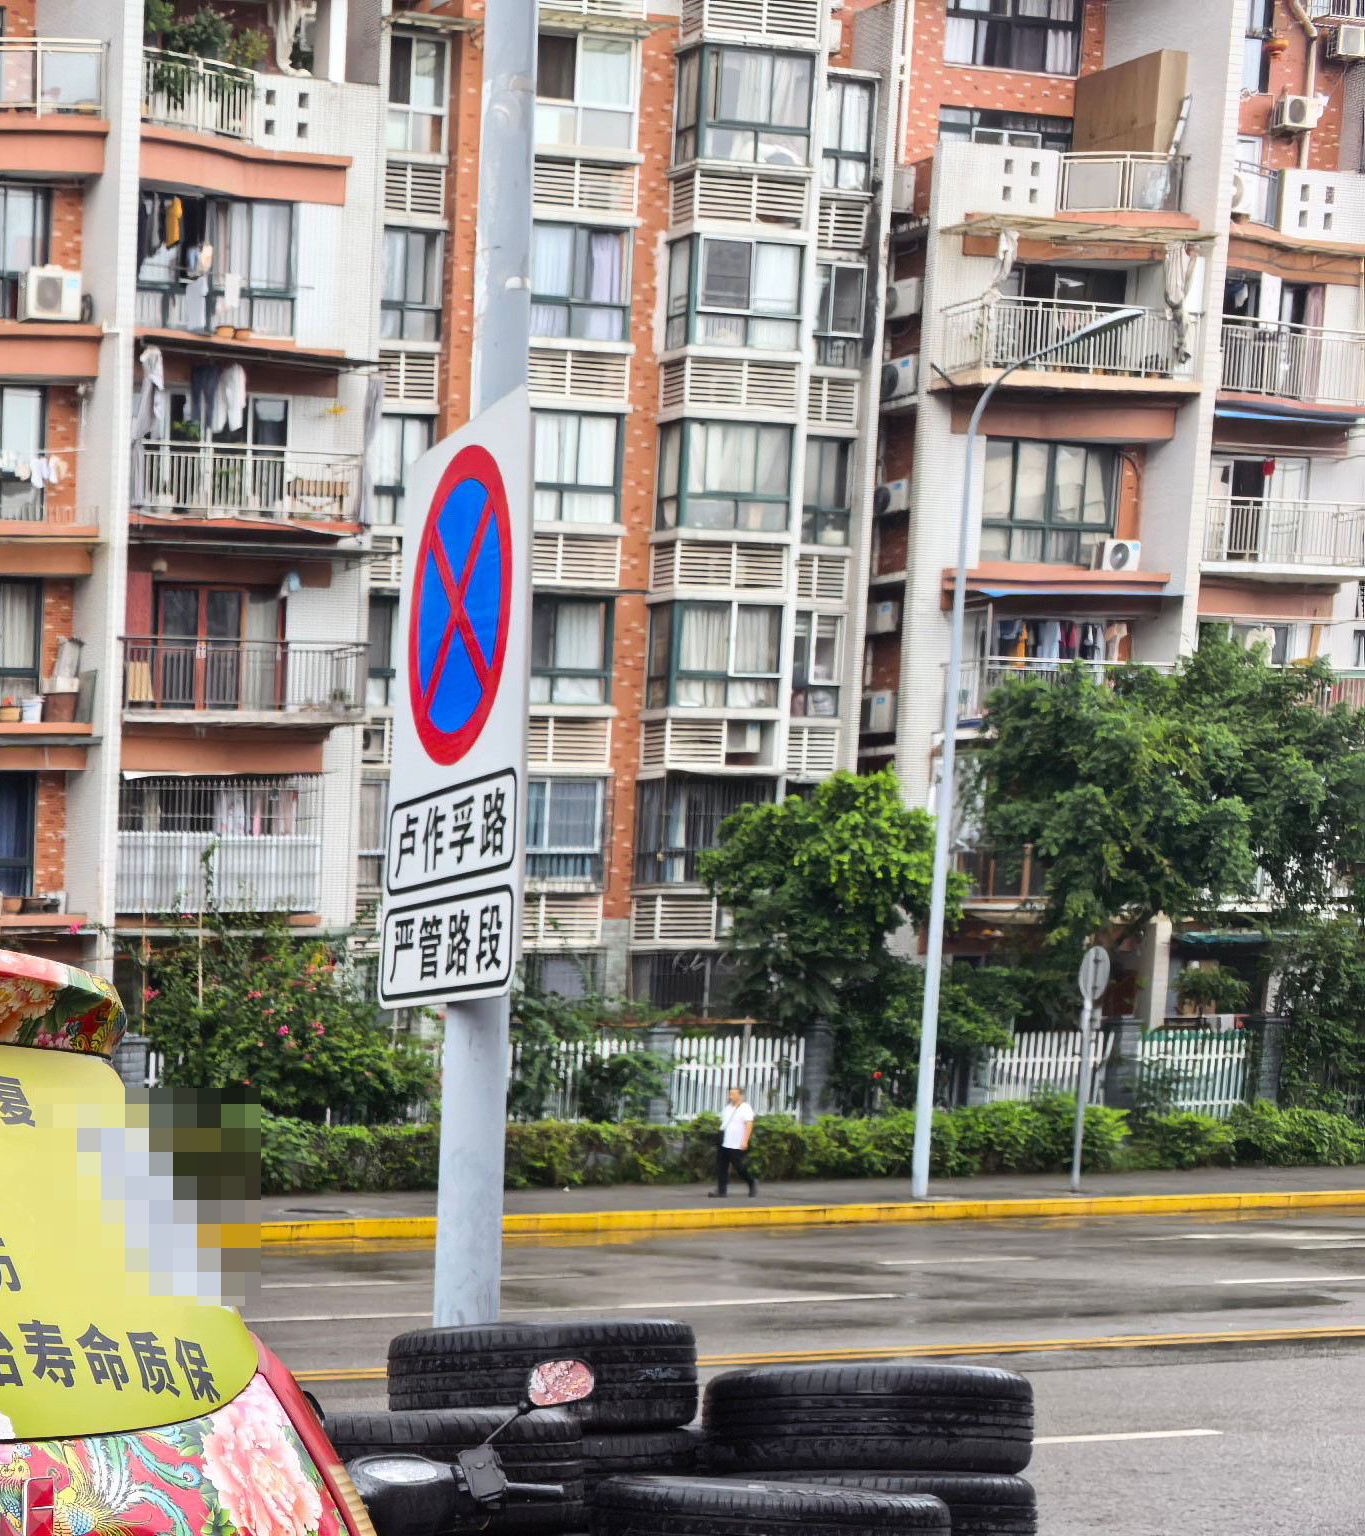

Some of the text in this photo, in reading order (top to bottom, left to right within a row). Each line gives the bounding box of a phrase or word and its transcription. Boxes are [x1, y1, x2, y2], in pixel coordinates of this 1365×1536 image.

[395, 787, 508, 879] 卢作孚路
[389, 902, 503, 983] 严管路段
